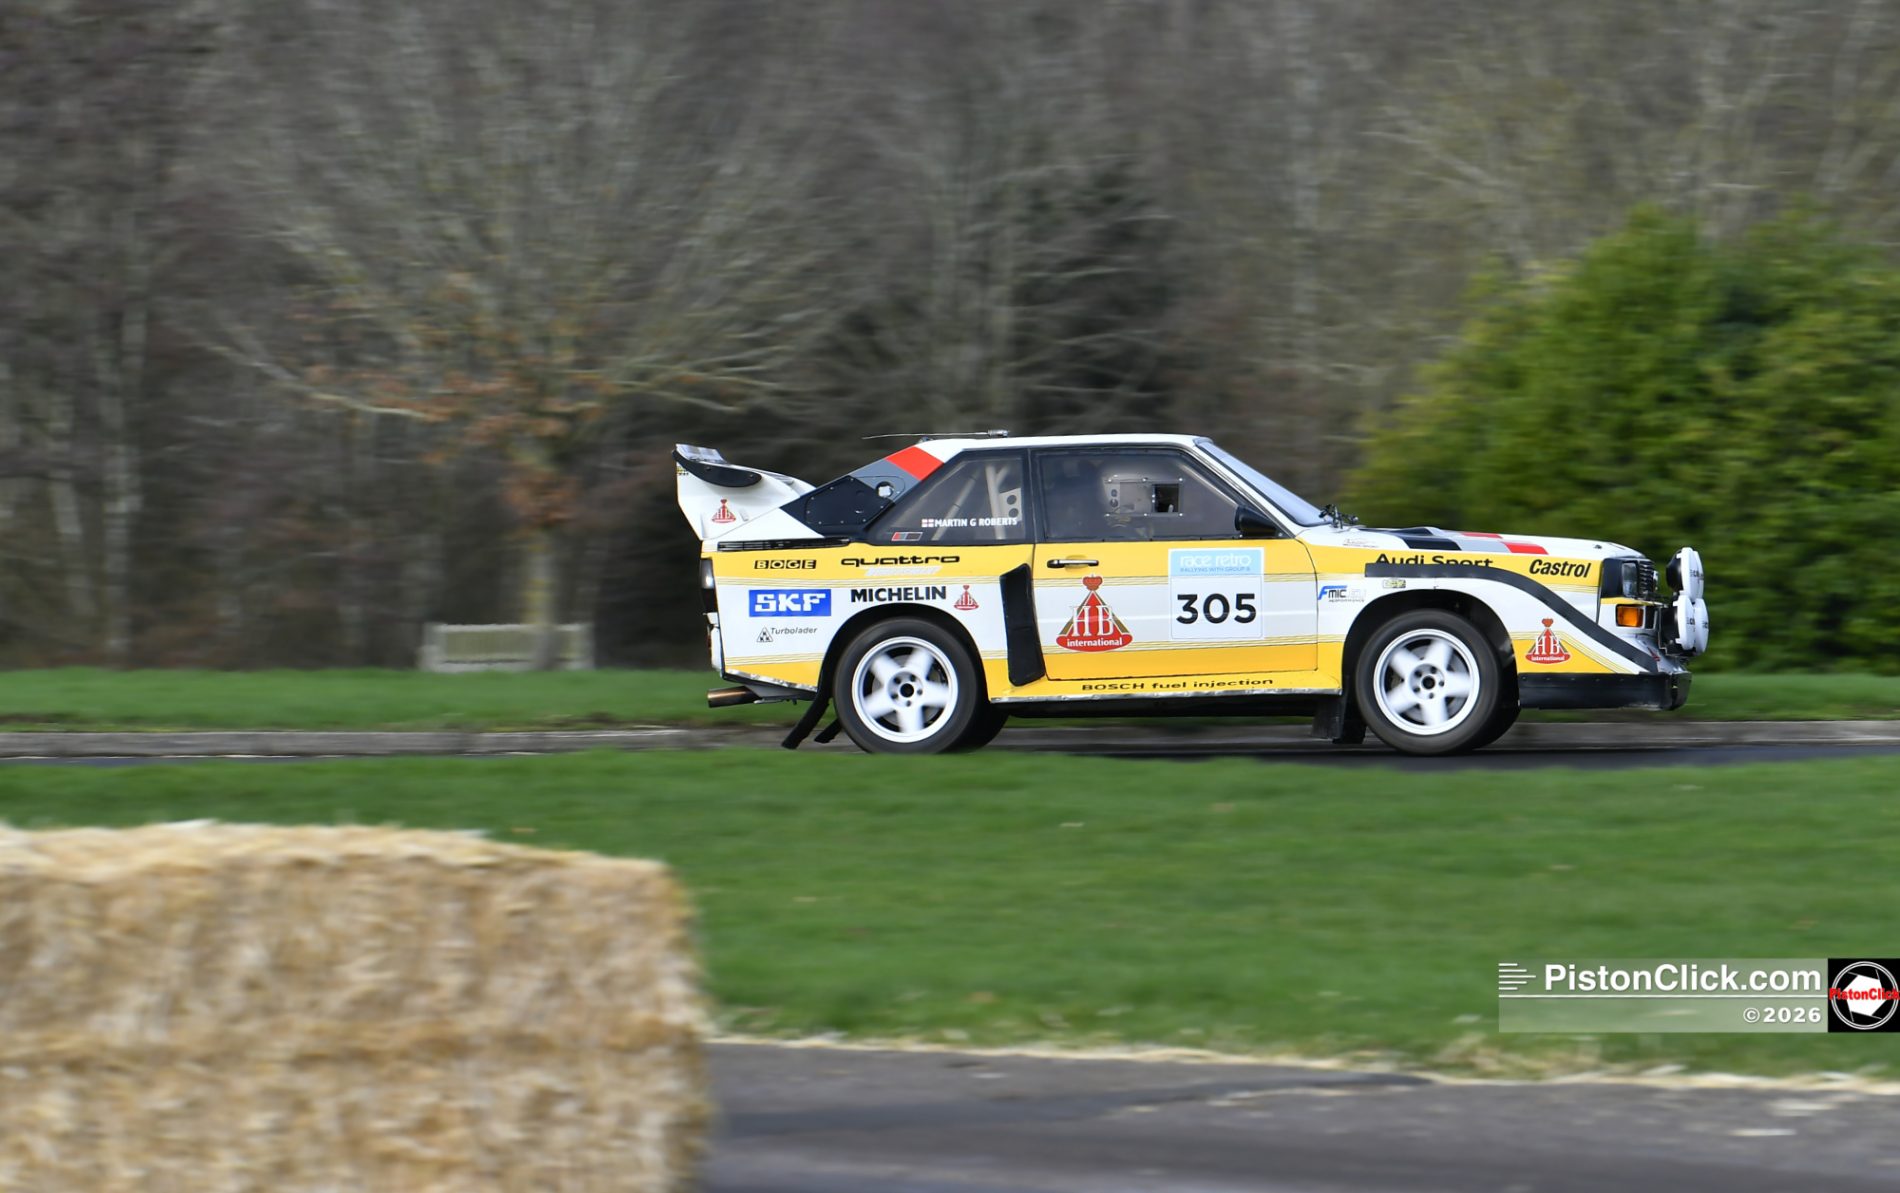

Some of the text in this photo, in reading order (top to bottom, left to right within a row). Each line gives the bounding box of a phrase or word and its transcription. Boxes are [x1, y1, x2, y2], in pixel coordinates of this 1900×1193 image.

[934, 517, 1017, 528] MARTIN G ROBERTS
[755, 559, 816, 569] BOGE
[841, 556, 960, 567] quattro
[1180, 553, 1252, 567] race retro
[1376, 553, 1424, 565] Audi
[1529, 559, 1591, 578] Castrol
[851, 586, 946, 602] MICHELIN
[755, 593, 826, 612] SKF
[1176, 593, 1257, 624] 305
[1070, 605, 1115, 637] HB
[771, 627, 817, 635] Turbolader
[1067, 637, 1123, 647] international
[1535, 635, 1560, 655] HB
[1082, 683, 1144, 691] BOSCH
[1193, 679, 1273, 689] injection
